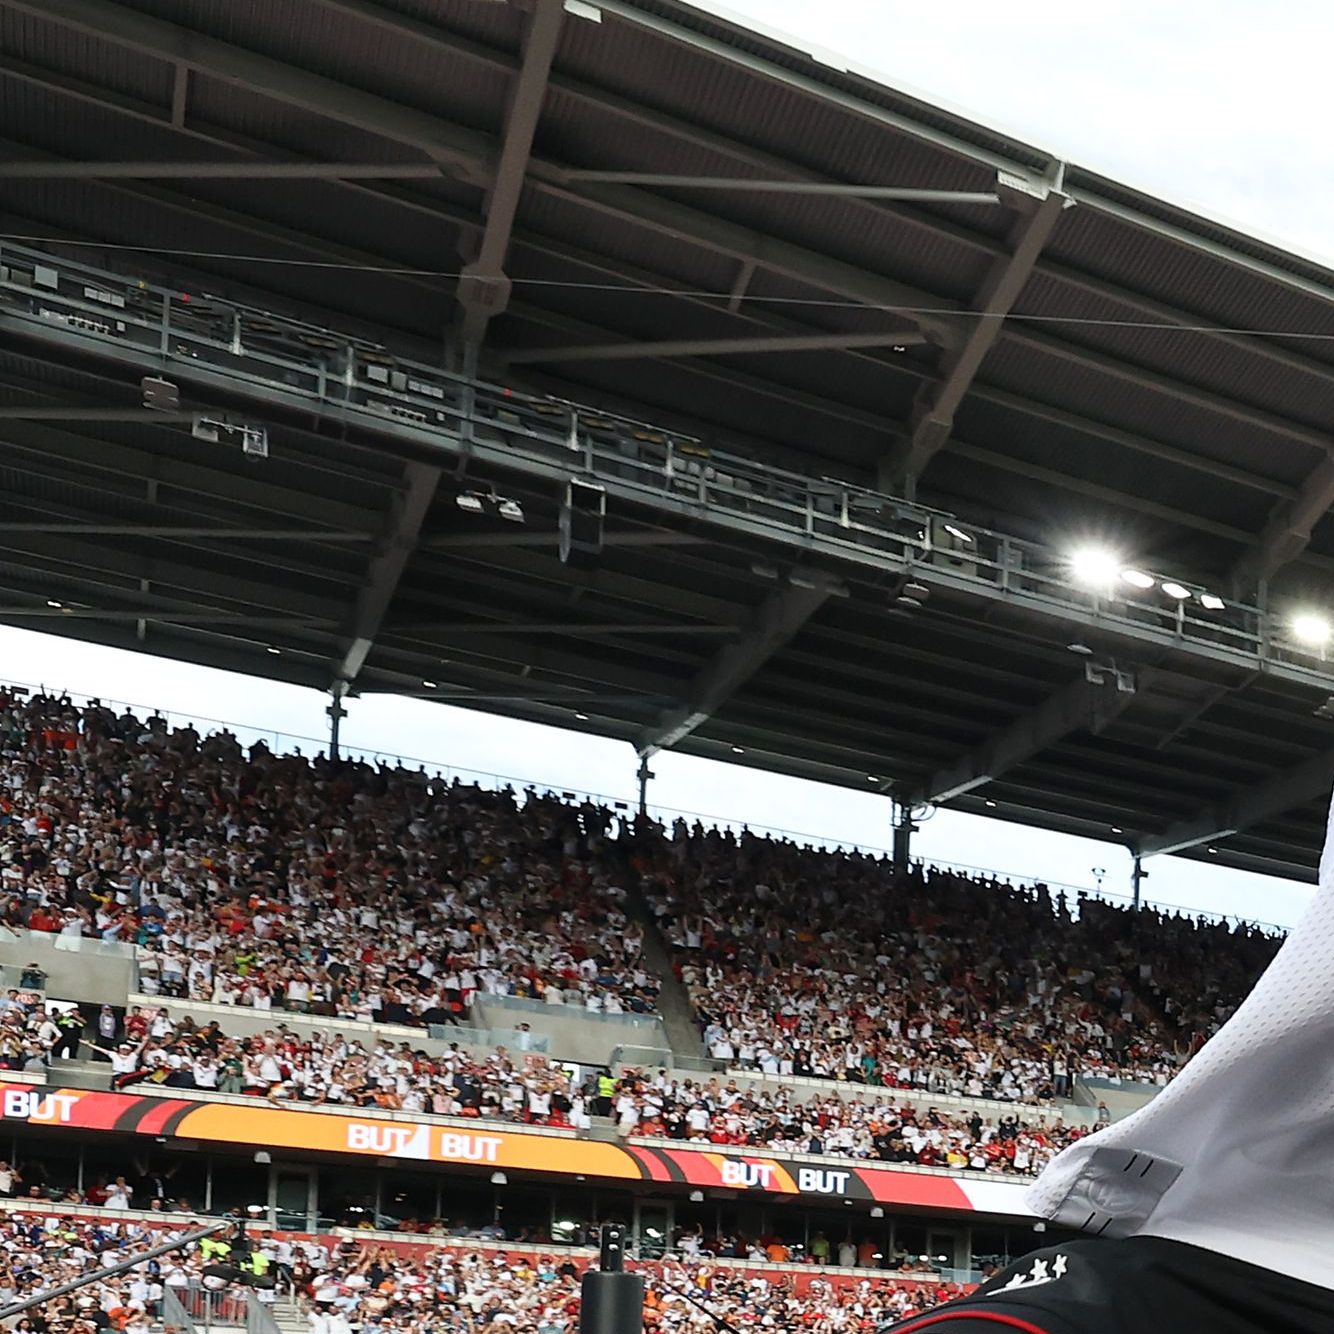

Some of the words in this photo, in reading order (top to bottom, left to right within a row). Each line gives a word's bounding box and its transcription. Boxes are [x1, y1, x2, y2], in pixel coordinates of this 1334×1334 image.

[4, 1089, 80, 1122] BUT
[347, 1123, 412, 1156] BUT
[441, 1133, 503, 1162] BUT
[722, 1160, 775, 1188] BUT
[799, 1168, 851, 1194] BUT
